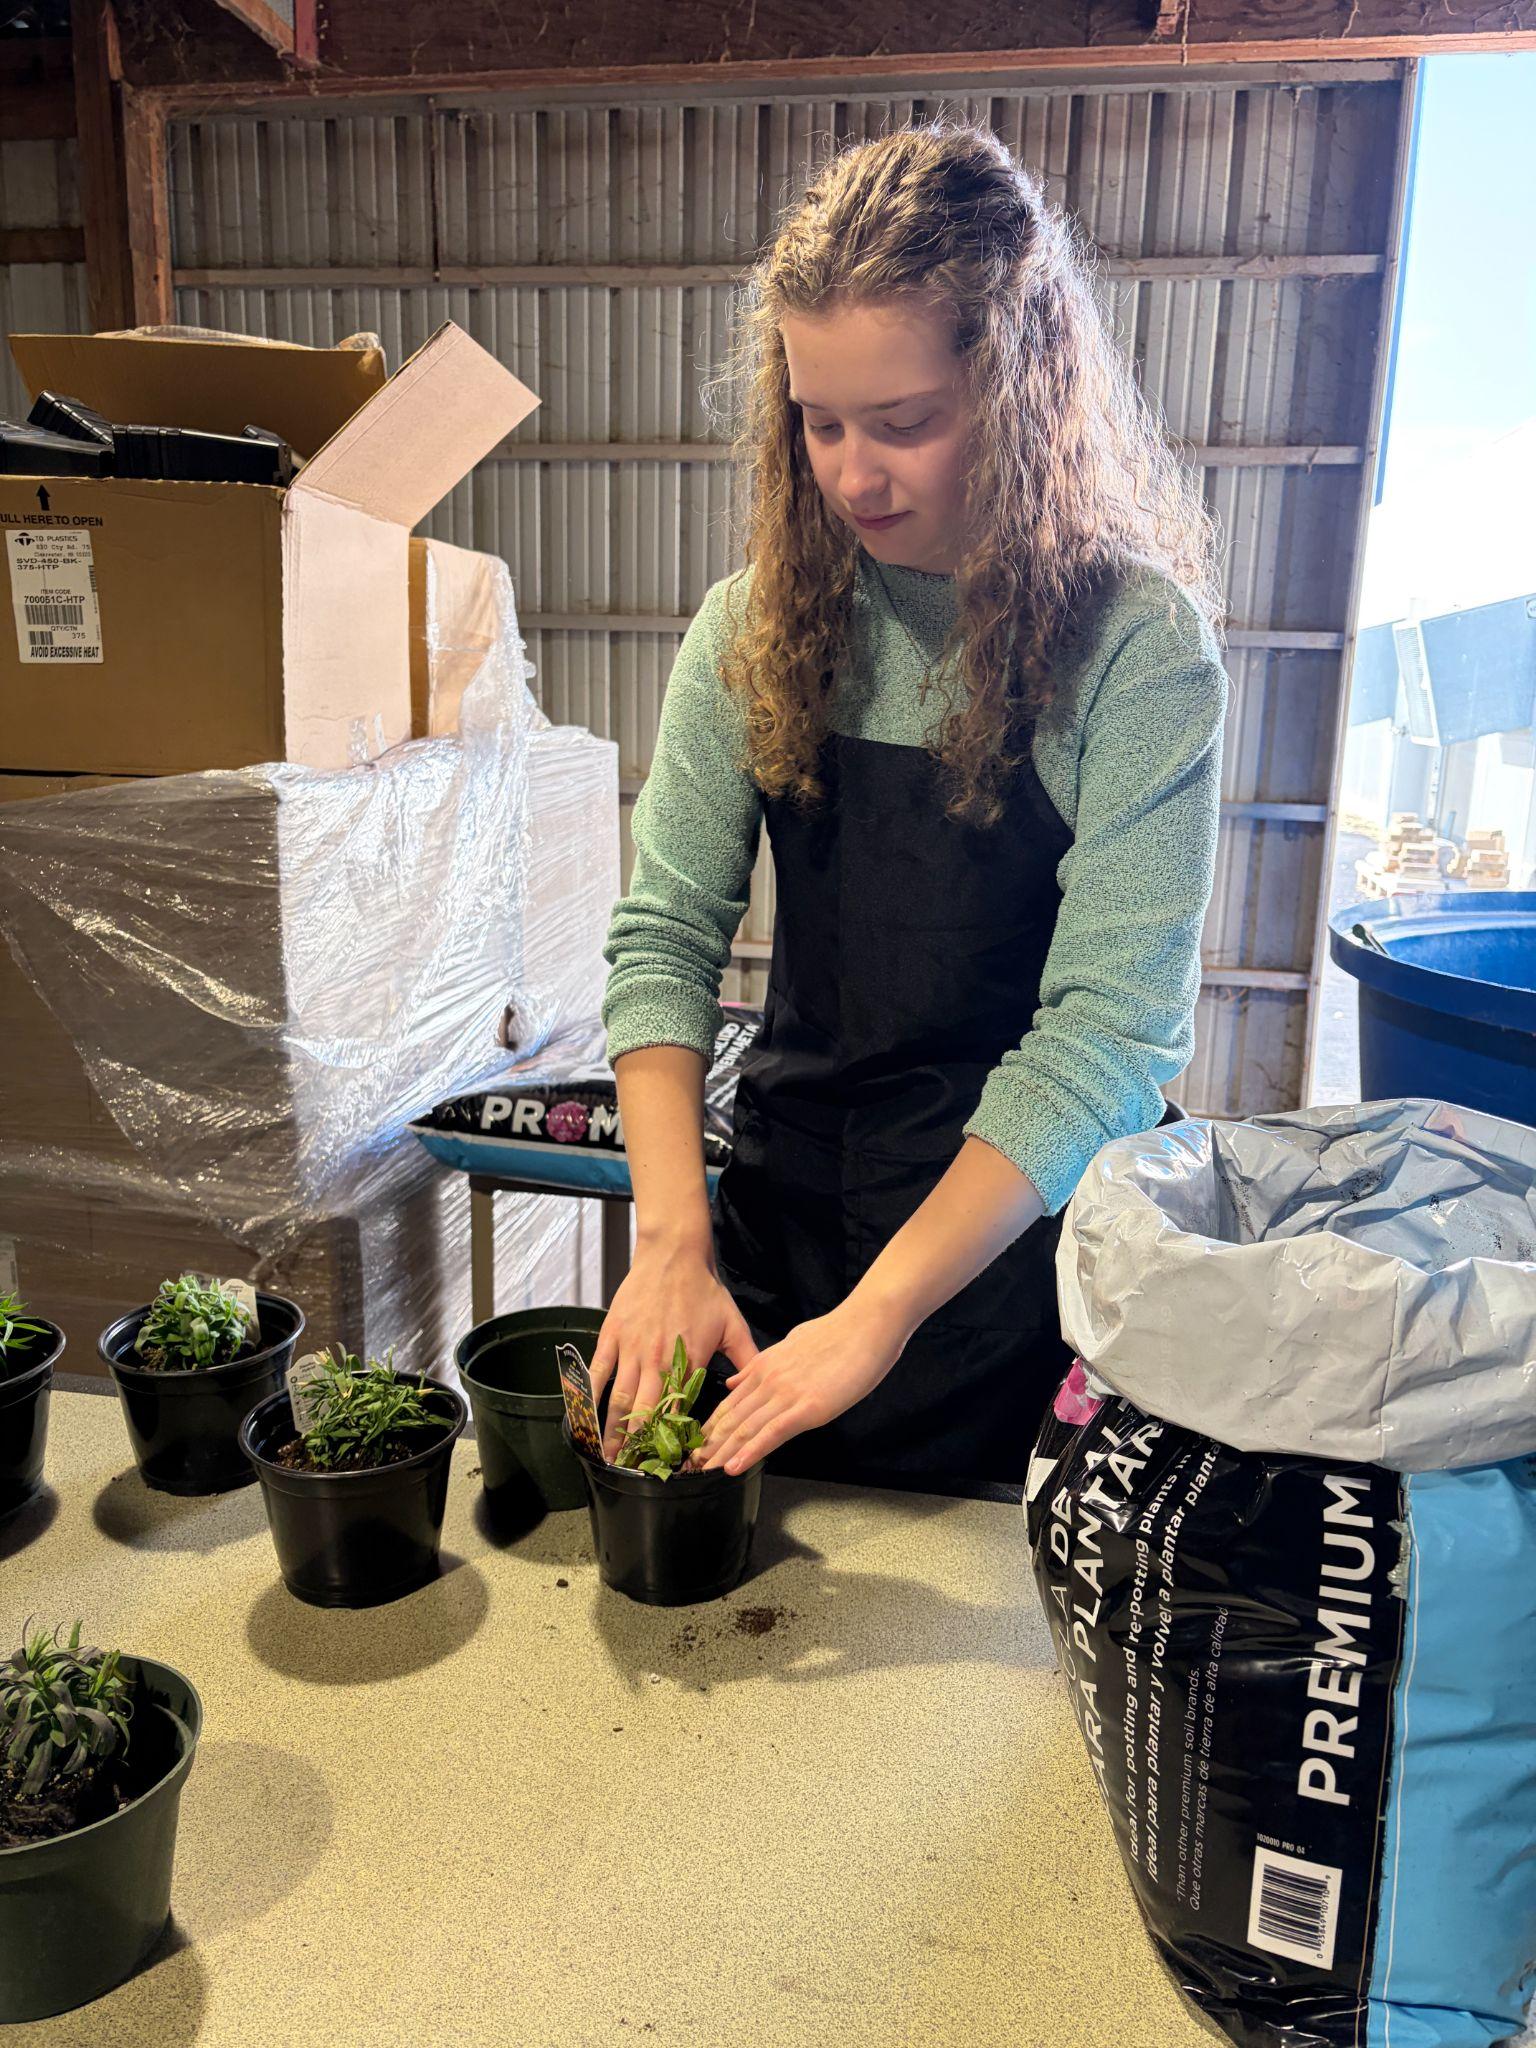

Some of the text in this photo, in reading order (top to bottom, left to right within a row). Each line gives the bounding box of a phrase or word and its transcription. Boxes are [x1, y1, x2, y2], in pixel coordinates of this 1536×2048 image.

[0, 513, 103, 526] ULL HERE TO OPEN
[24, 596, 86, 604] 700051C-HTP
[30, 646, 100, 658] AVOID EXCESSIVE HEAT
[72, 632, 86, 640] 375
[1184, 1439, 1221, 1507] planta
[1051, 1486, 1074, 1566] DE
[1138, 1474, 1178, 1535] plants
[1073, 1420, 1164, 1663] PLANTAR
[1158, 1505, 1187, 1588] plantar
[1127, 1538, 1150, 1644] re-potting
[1158, 1587, 1172, 1602] a
[1150, 1603, 1174, 1671] volver
[1297, 1474, 1376, 1807] PREMIUM
[1122, 1647, 1138, 1689] and
[1149, 1673, 1166, 1692] y
[1184, 1666, 1200, 1724] brands.
[1122, 1693, 1139, 1775] potting
[1144, 1691, 1162, 1776] plantar
[1184, 1722, 1196, 1750] soil
[1189, 1605, 1229, 1911] Que otras marcas de tierra de alta calidad
[1126, 1775, 1138, 1807] for
[1146, 1776, 1161, 1830] para
[1180, 1753, 1193, 1820] premium
[1127, 1808, 1139, 1863] Ideal
[1145, 1823, 1160, 1884] Ideal
[1176, 1820, 1189, 1862] other
[1282, 1840, 1295, 1852] PRO
